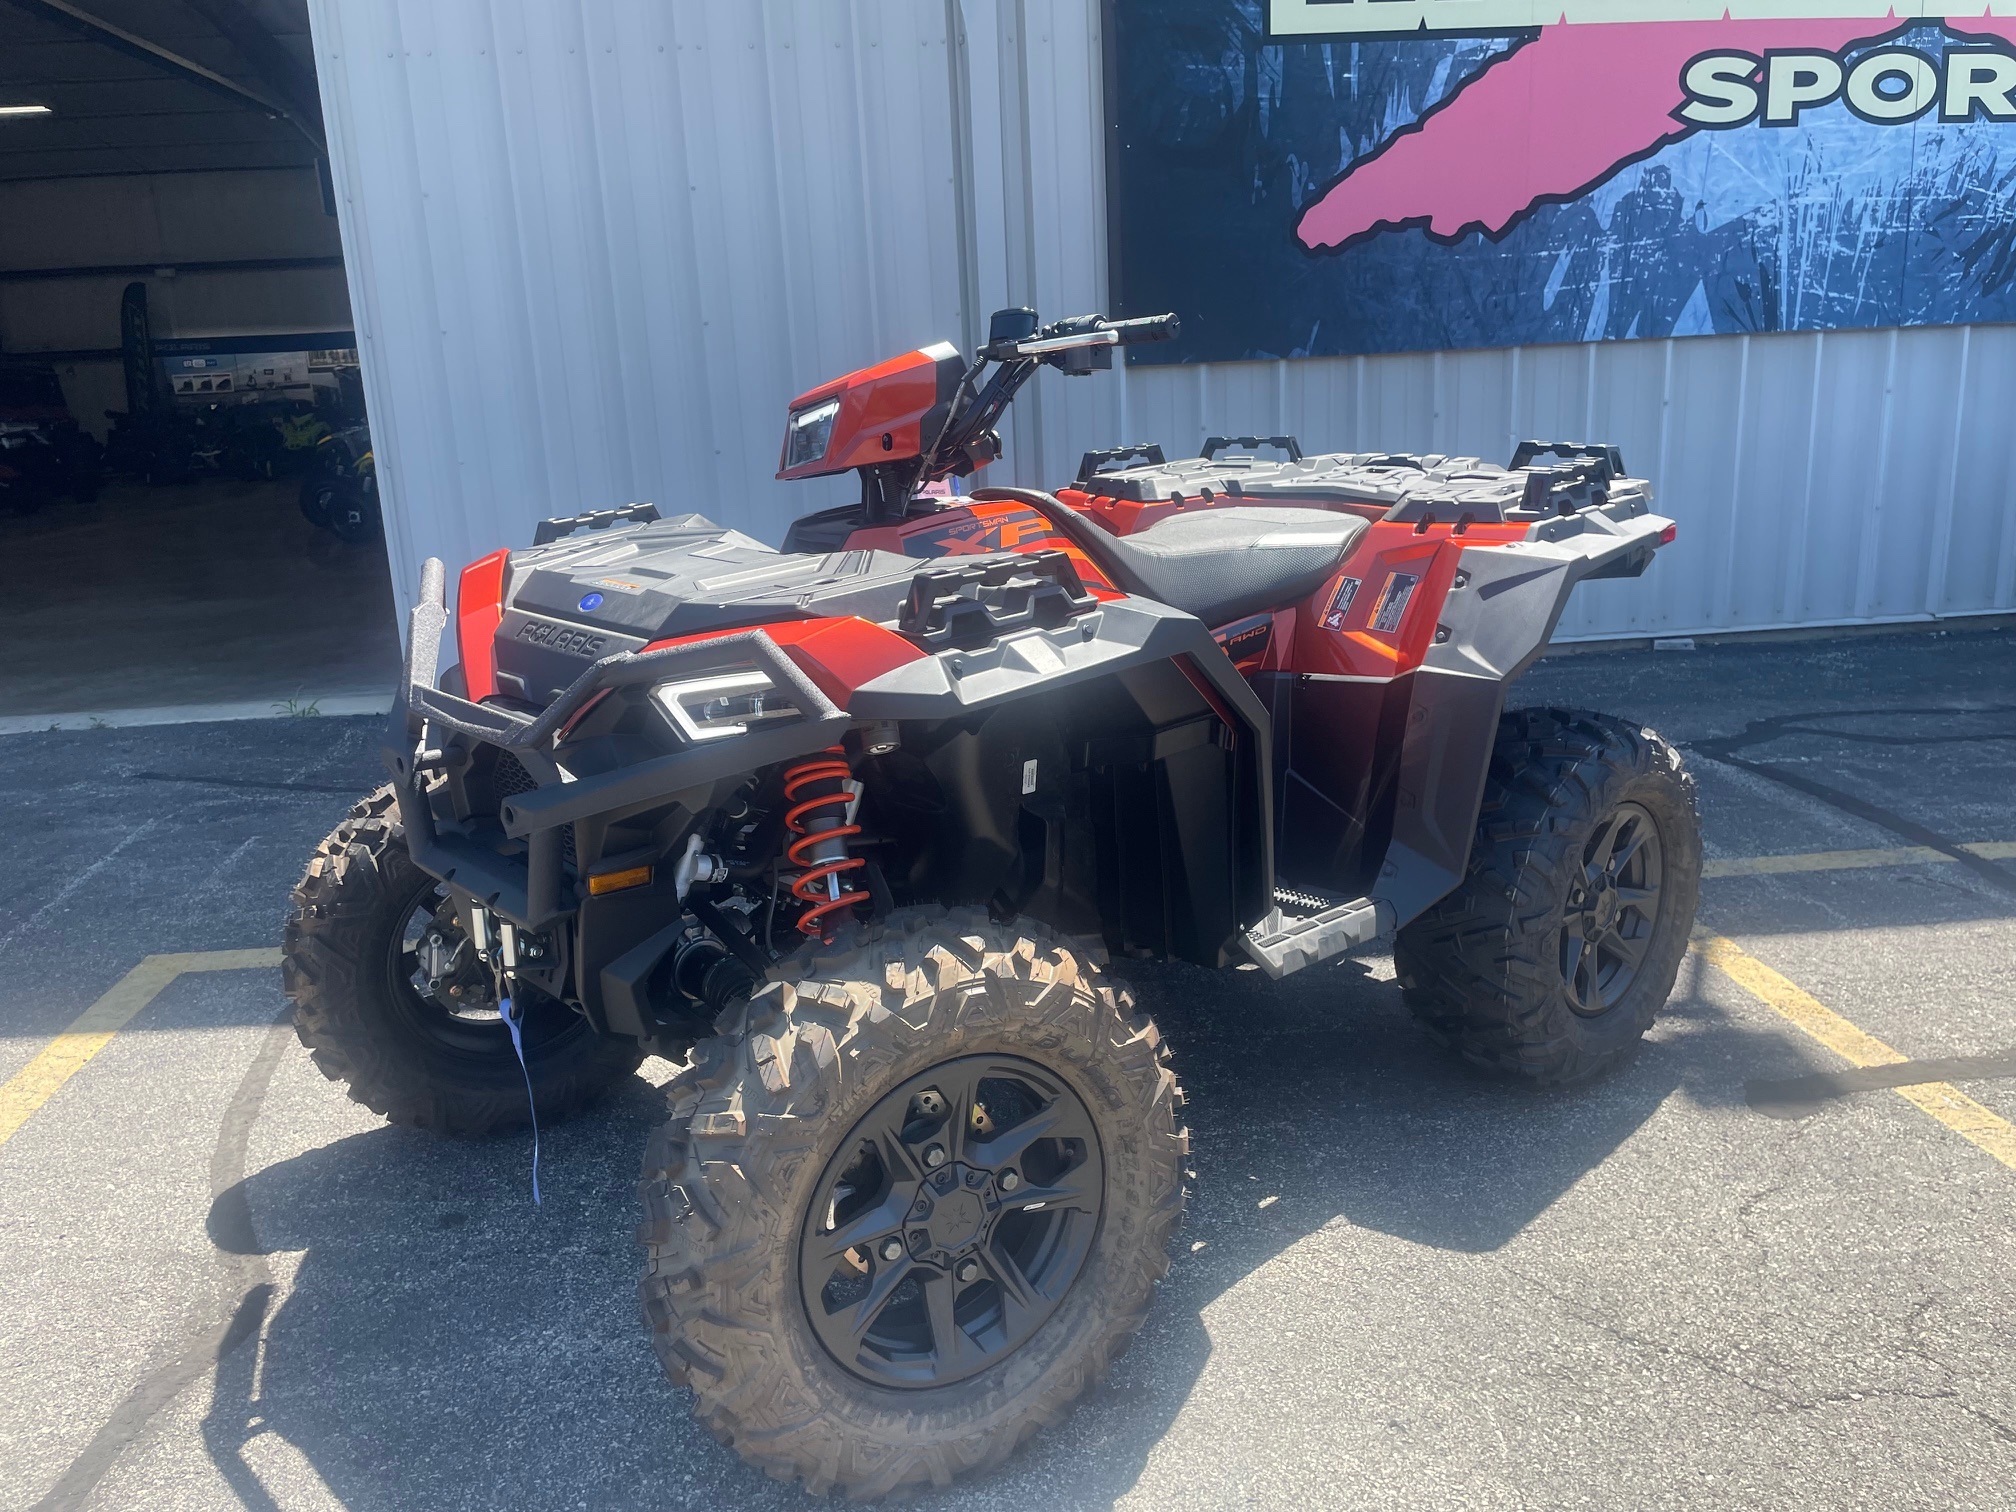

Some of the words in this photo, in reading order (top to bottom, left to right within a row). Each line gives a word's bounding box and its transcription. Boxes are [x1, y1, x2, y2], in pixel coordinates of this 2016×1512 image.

[1681, 52, 2016, 121] SPOR
[933, 517, 1053, 557] XP
[949, 516, 1009, 536] SPORTSMAN
[516, 620, 606, 658] POLARIS
[1229, 625, 1267, 646] AWD
